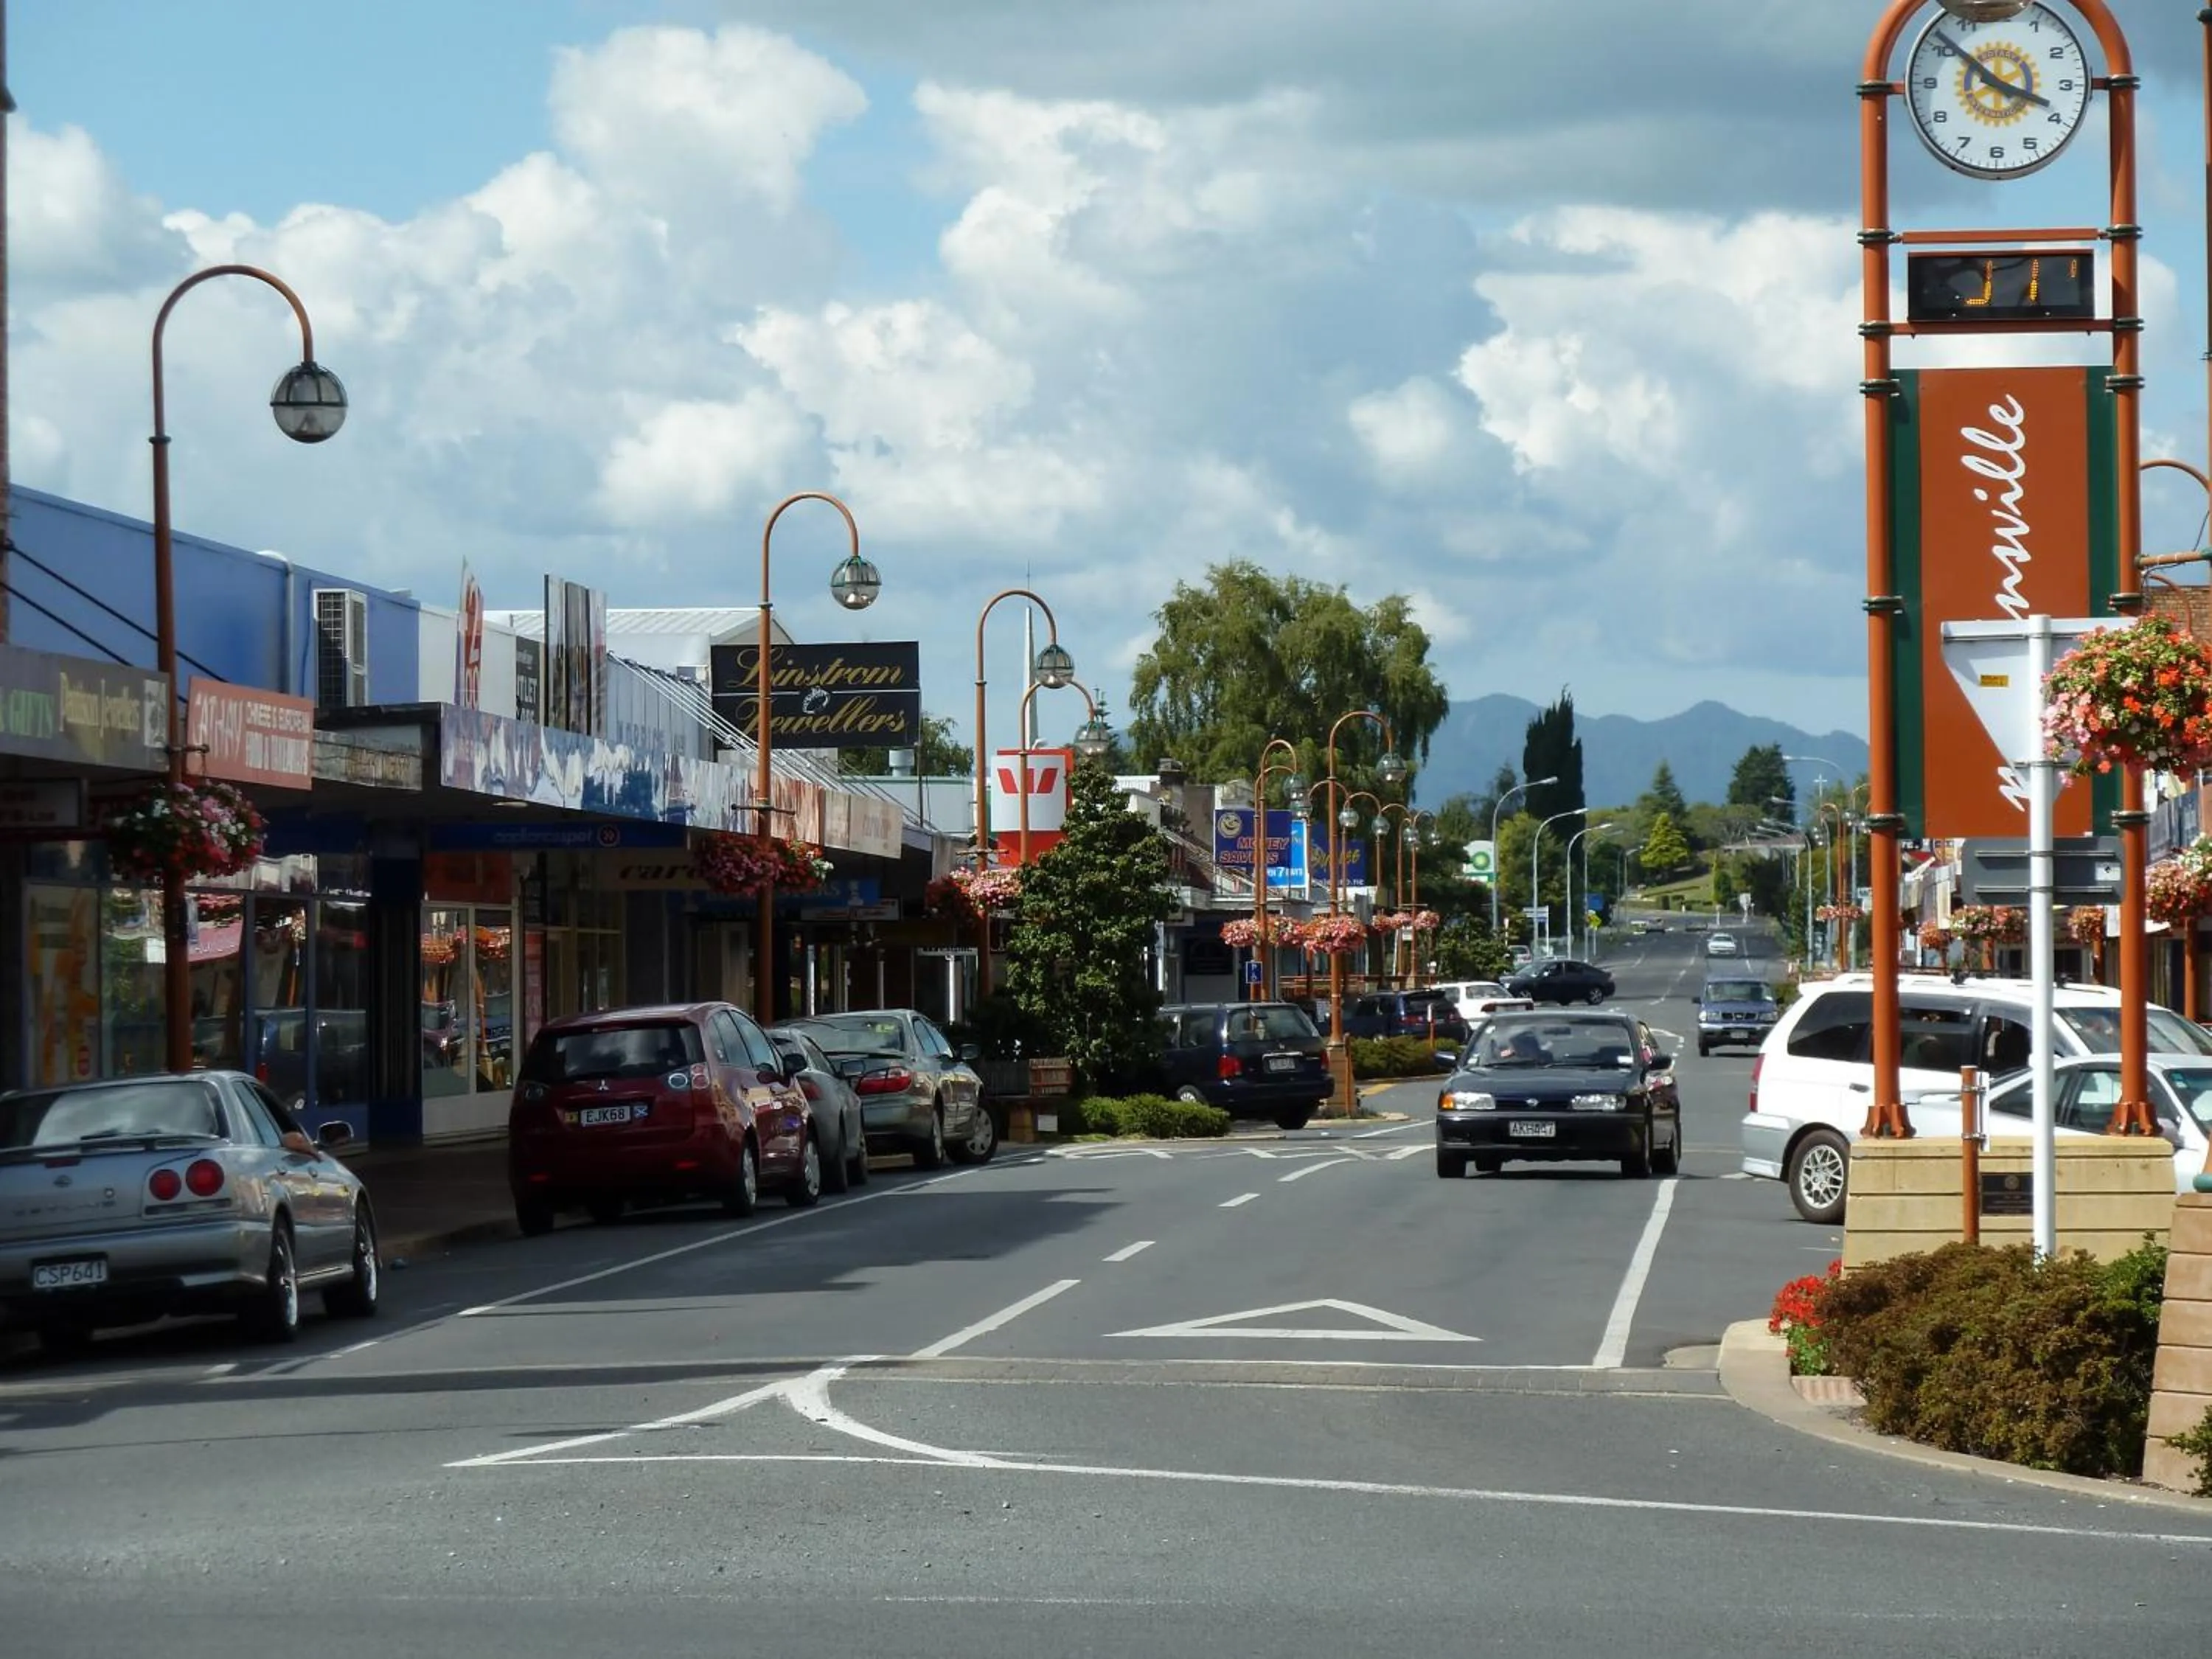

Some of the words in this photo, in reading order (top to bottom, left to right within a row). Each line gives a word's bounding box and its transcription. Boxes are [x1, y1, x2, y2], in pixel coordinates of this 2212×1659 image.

[2028, 20, 2039, 32] 1
[2050, 46, 2064, 60] 2
[1924, 77, 1937, 90] 9
[2059, 78, 2073, 91] 3
[1933, 111, 1947, 123] 8
[2048, 112, 2062, 125] 4
[1958, 136, 1972, 149] 7
[2023, 137, 2037, 150] 5
[1990, 146, 2004, 159] 6
[726, 646, 905, 689] Linstrom
[585, 1107, 626, 1123] EJK68
[35, 1262, 104, 1285] CSP641
